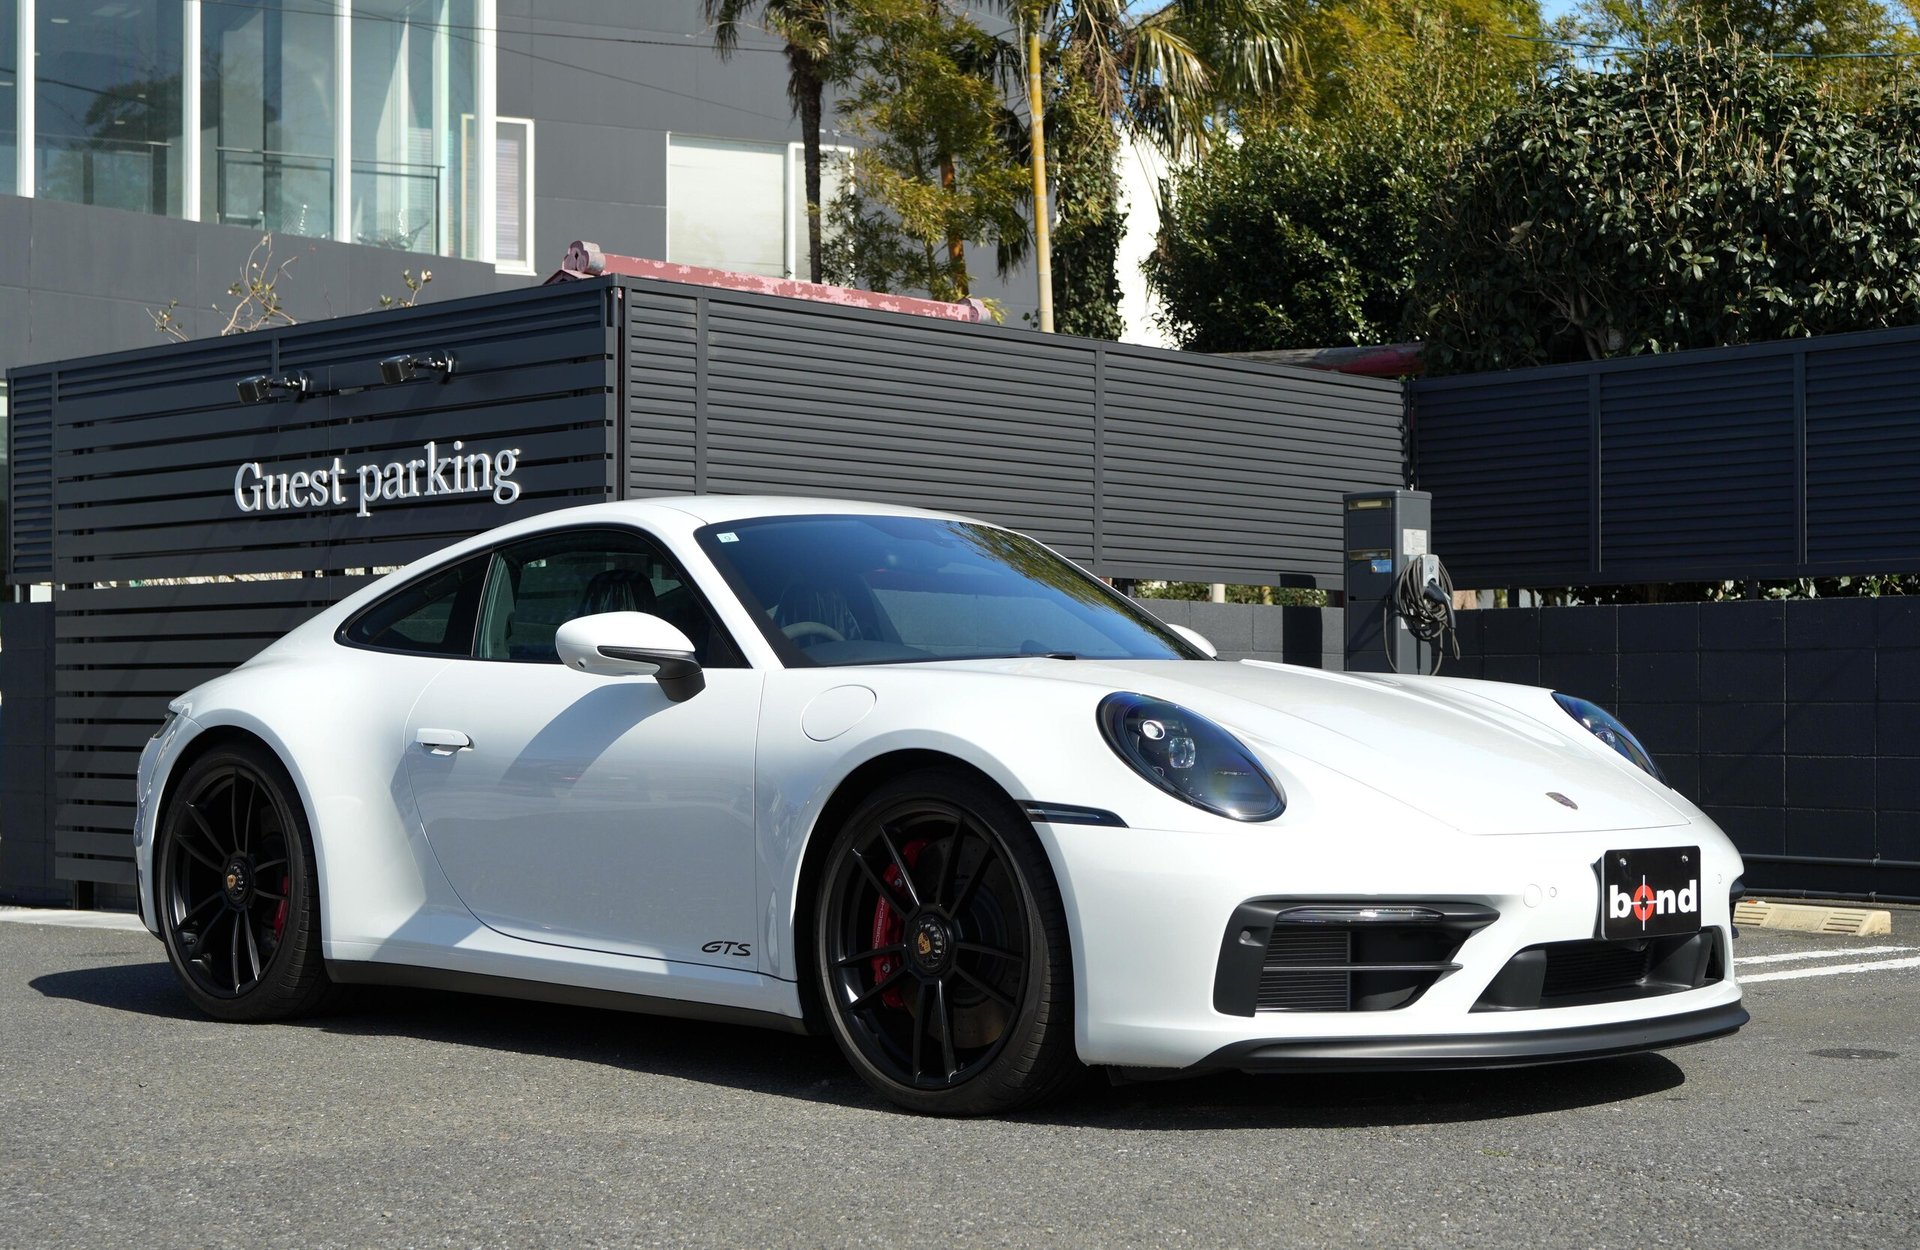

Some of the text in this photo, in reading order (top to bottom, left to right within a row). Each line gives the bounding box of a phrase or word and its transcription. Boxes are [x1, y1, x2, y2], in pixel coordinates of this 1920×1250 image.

[234, 440, 520, 517] Guest parking
[1609, 879, 1698, 921] bond
[701, 940, 751, 957] GTS
